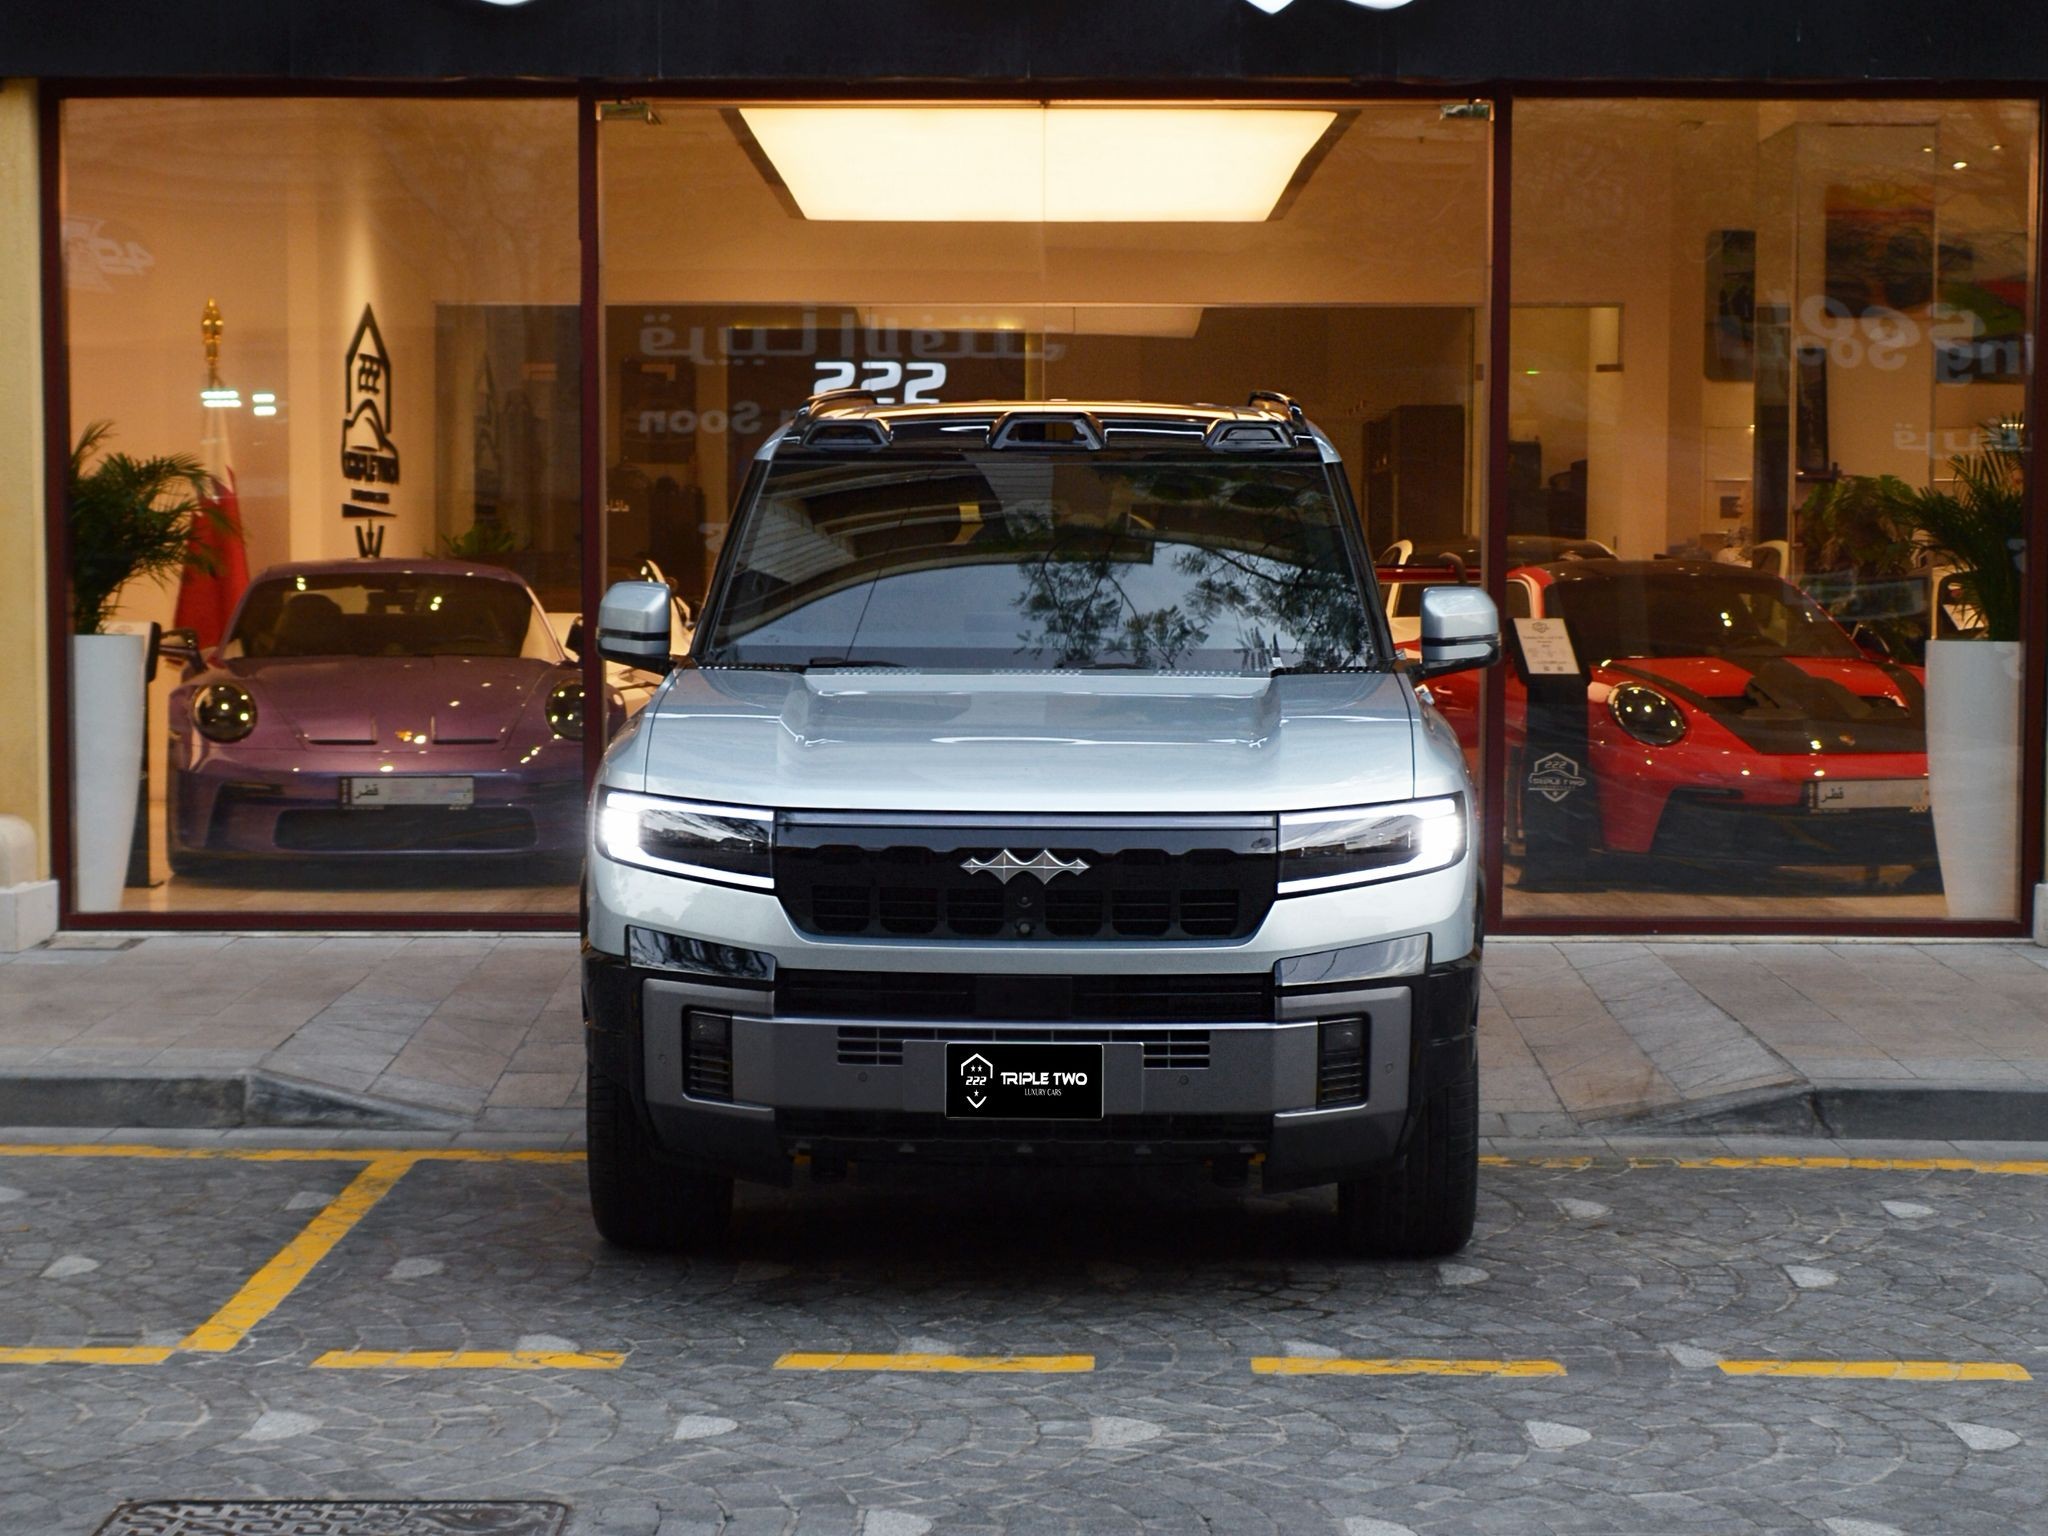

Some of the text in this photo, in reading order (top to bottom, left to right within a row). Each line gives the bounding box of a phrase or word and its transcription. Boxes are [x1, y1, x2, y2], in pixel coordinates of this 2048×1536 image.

[813, 361, 947, 405] 222
[965, 1076, 987, 1086] 222
[1000, 1072, 1088, 1086] TRIPLE TWO
[1024, 1088, 1062, 1097] LUXURY CARS
